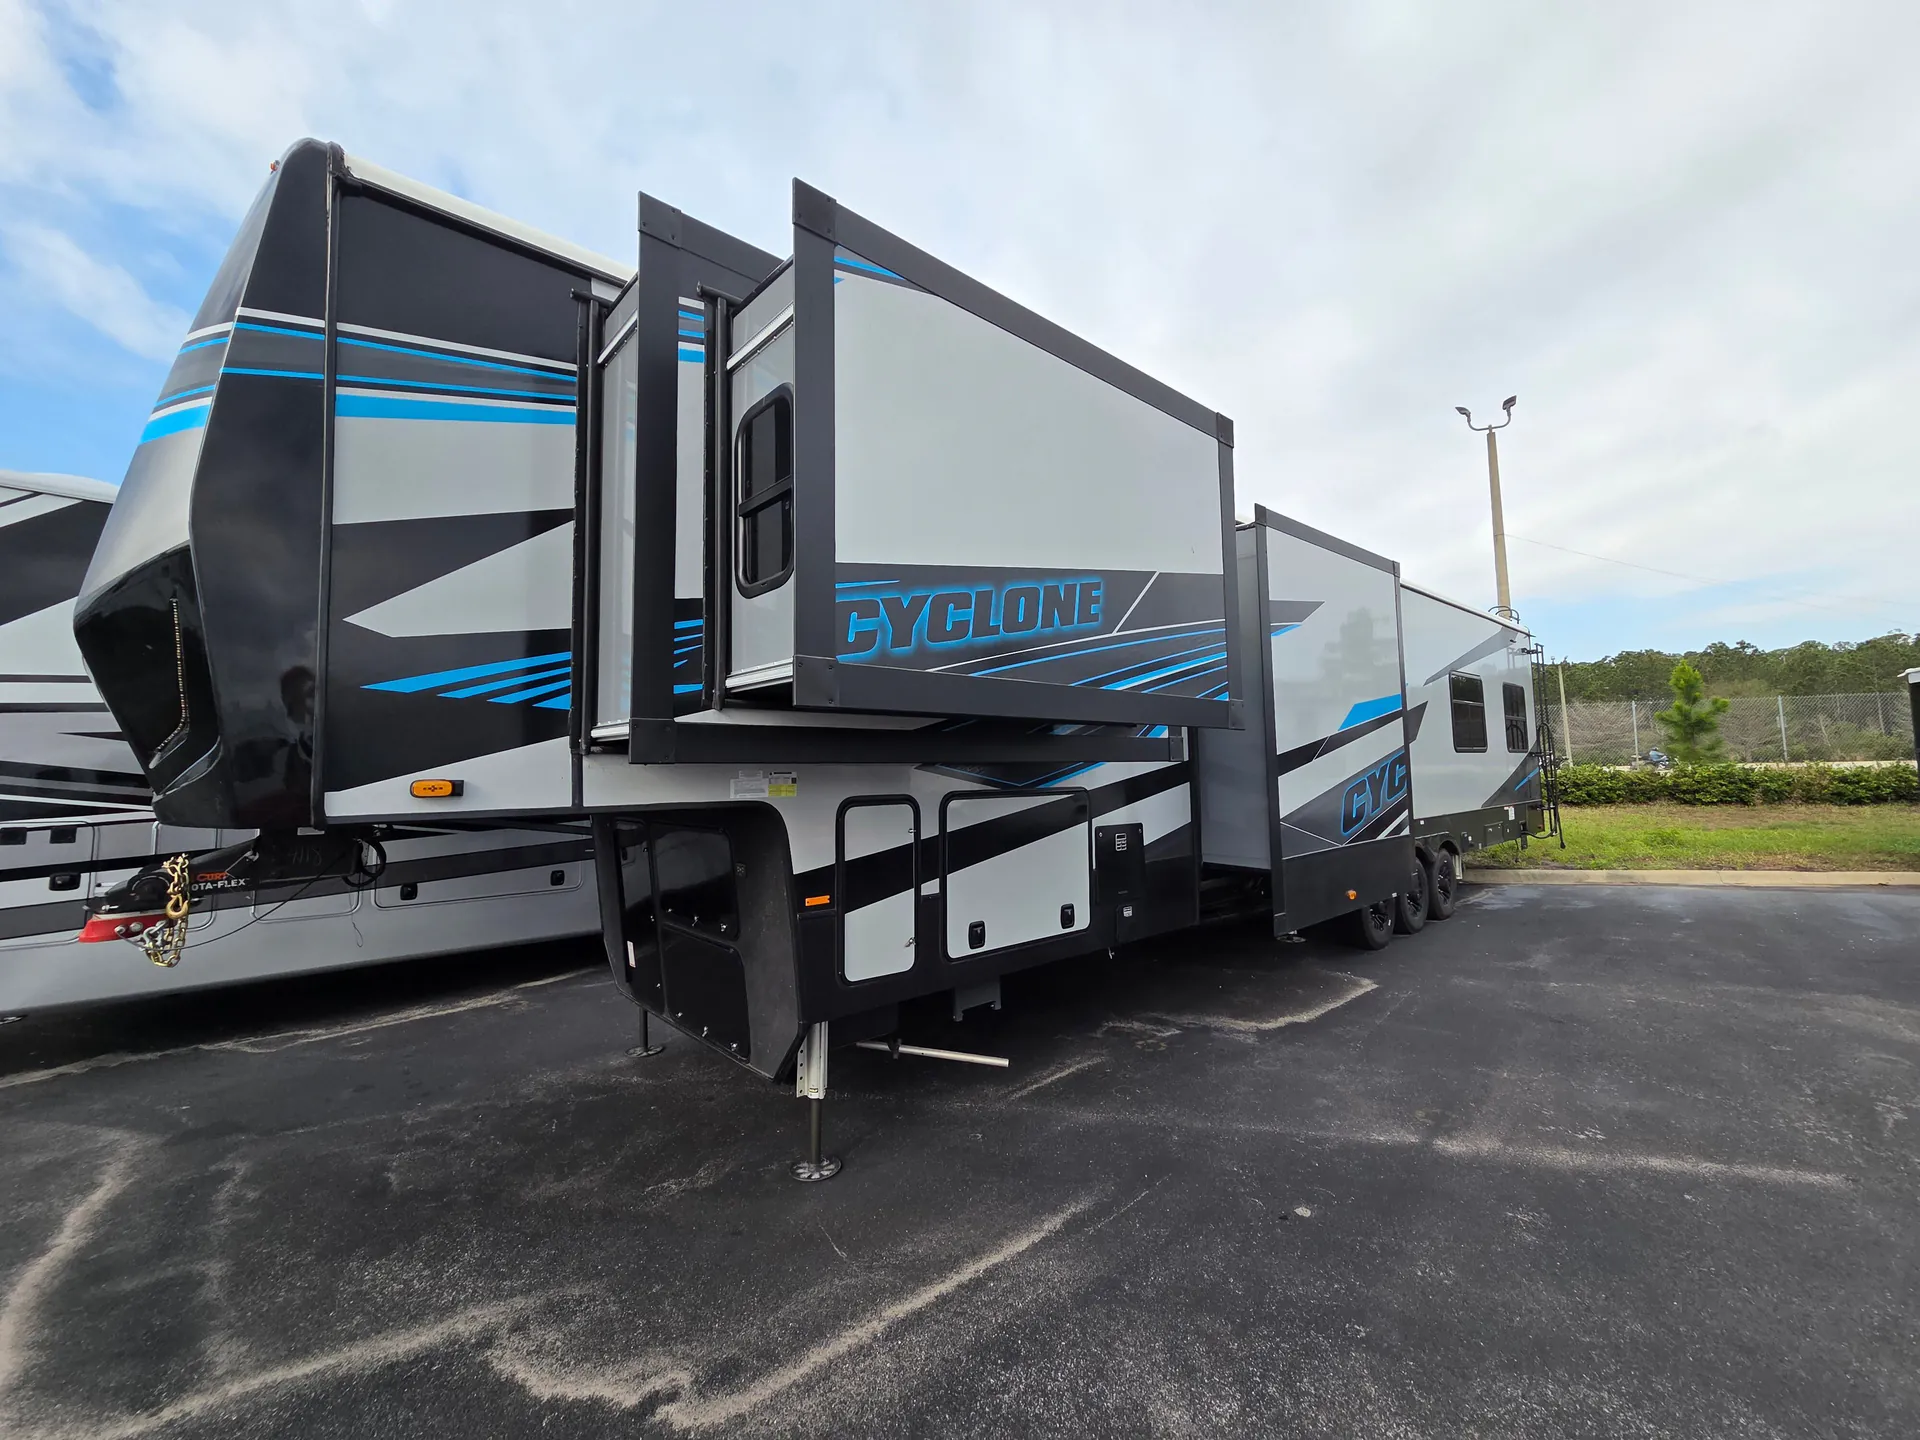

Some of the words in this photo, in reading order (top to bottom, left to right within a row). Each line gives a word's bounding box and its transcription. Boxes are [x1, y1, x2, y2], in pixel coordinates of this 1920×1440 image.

[836, 582, 1102, 661] CYCLONE
[1342, 750, 1407, 835] CYC
[188, 878, 246, 891] OTA-FLEX
